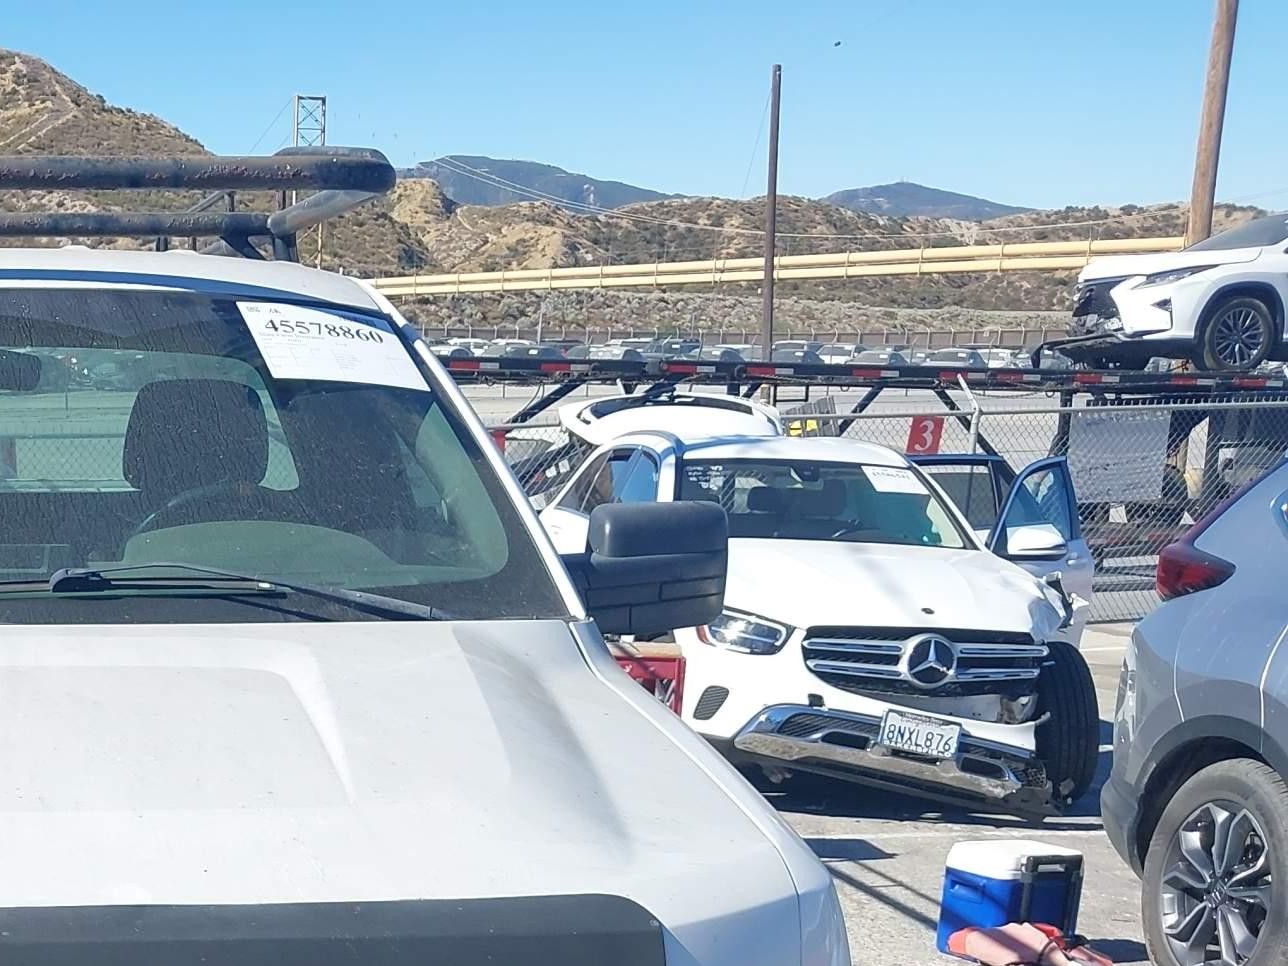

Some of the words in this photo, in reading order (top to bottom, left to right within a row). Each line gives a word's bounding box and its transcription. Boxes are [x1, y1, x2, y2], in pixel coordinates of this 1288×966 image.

[264, 318, 384, 344] 45578860
[914, 419, 935, 451] 3
[886, 723, 954, 752] 8NXL876
